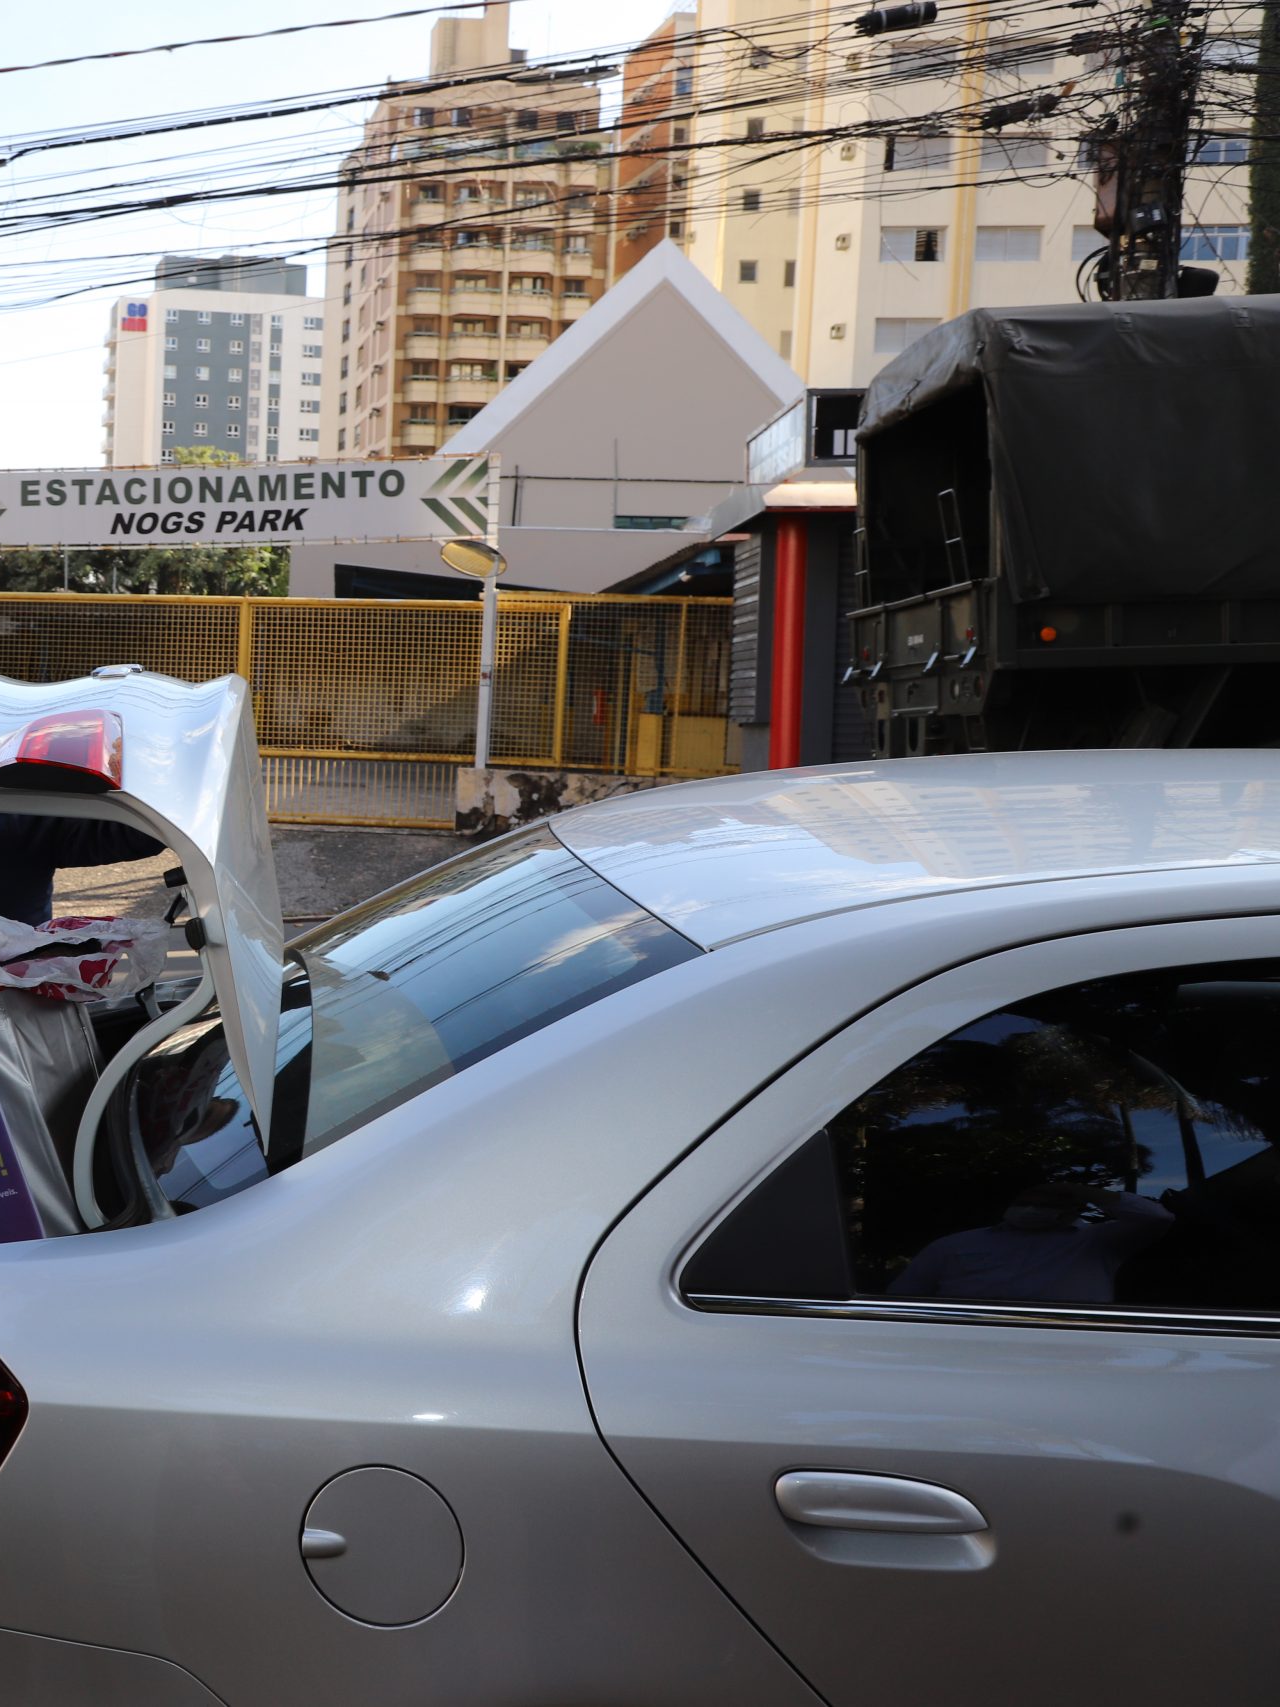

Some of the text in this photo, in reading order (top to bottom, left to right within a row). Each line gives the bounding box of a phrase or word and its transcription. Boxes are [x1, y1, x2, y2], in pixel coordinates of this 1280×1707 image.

[20, 469, 405, 507] ESTACIONAMENTO
[110, 508, 309, 535] NOGS PARK
